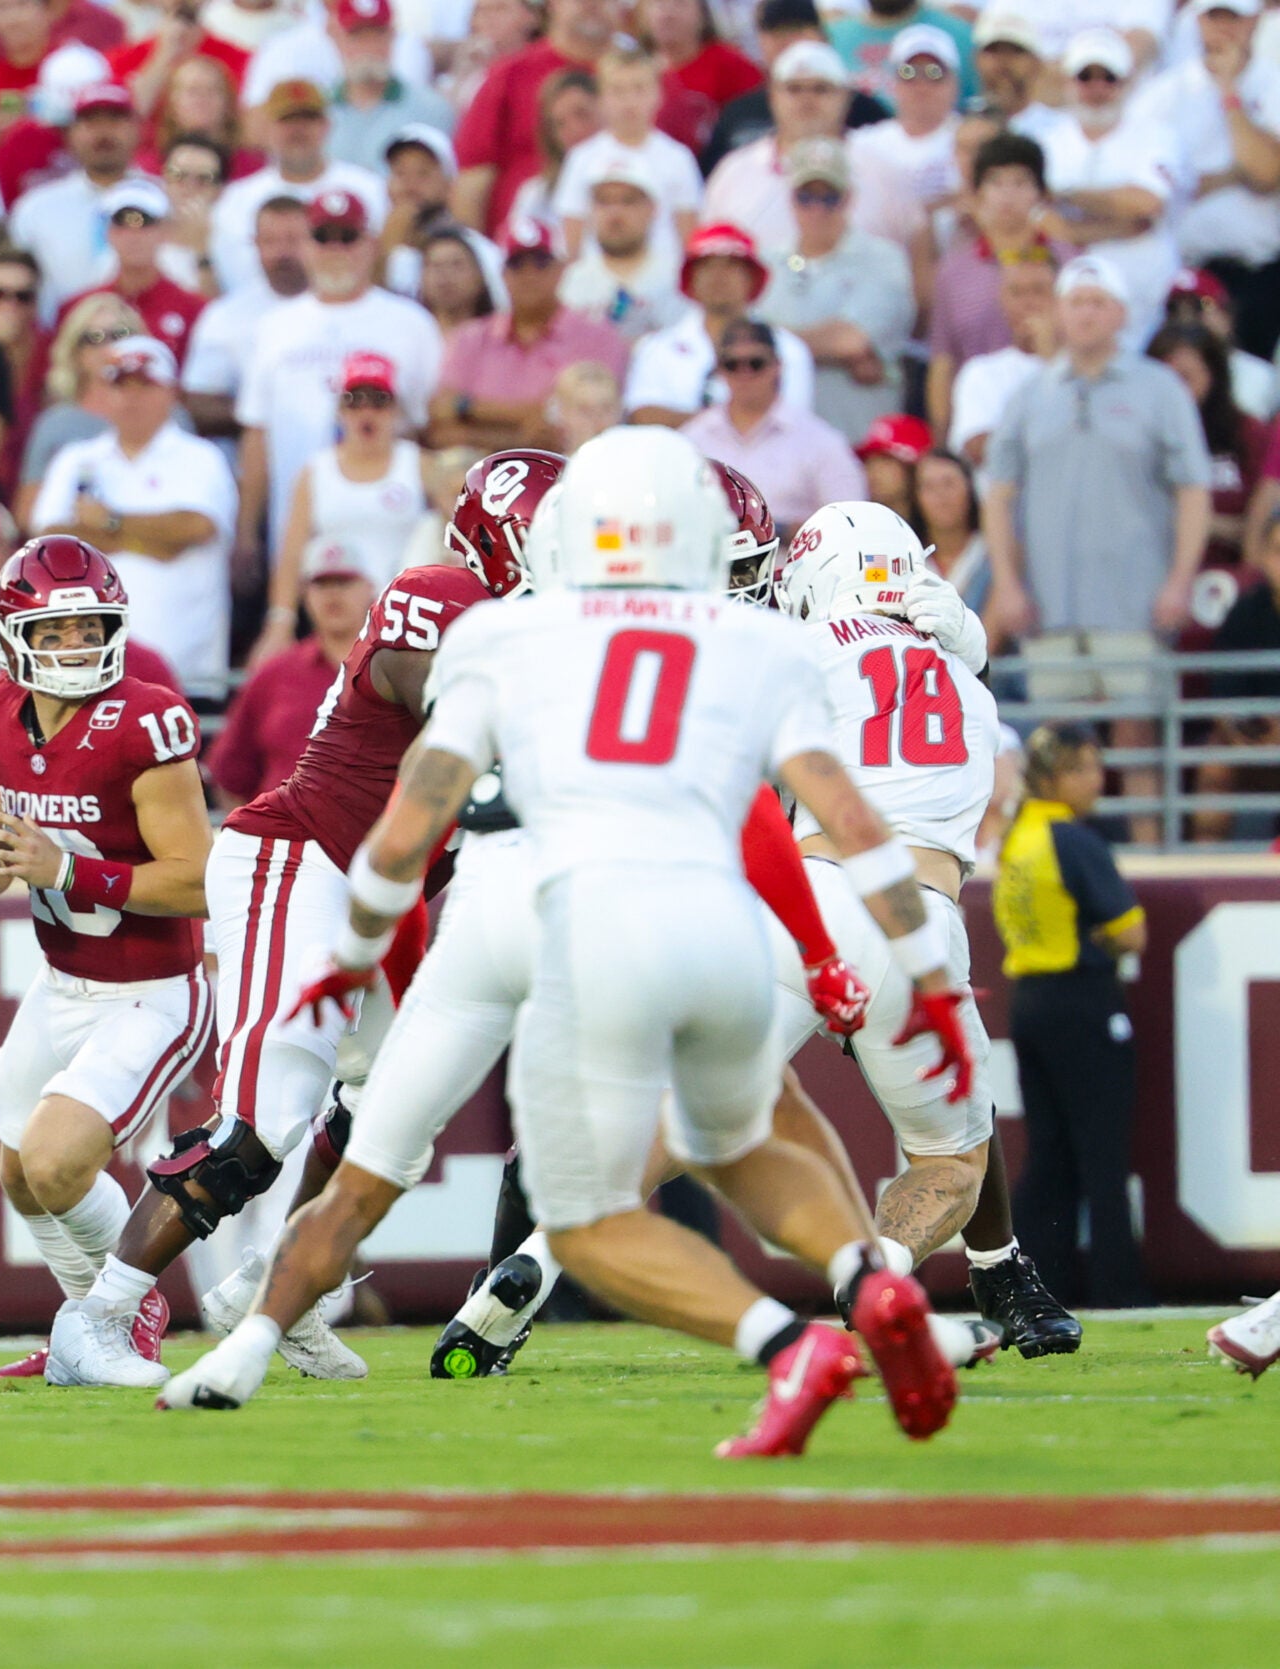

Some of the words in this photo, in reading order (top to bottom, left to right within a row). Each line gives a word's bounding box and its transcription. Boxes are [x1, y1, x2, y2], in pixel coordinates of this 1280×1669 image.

[380, 590, 444, 651] 55
[876, 591, 905, 602] GRIT
[585, 627, 697, 766] 0
[858, 645, 969, 767] 18
[138, 705, 196, 762] 10
